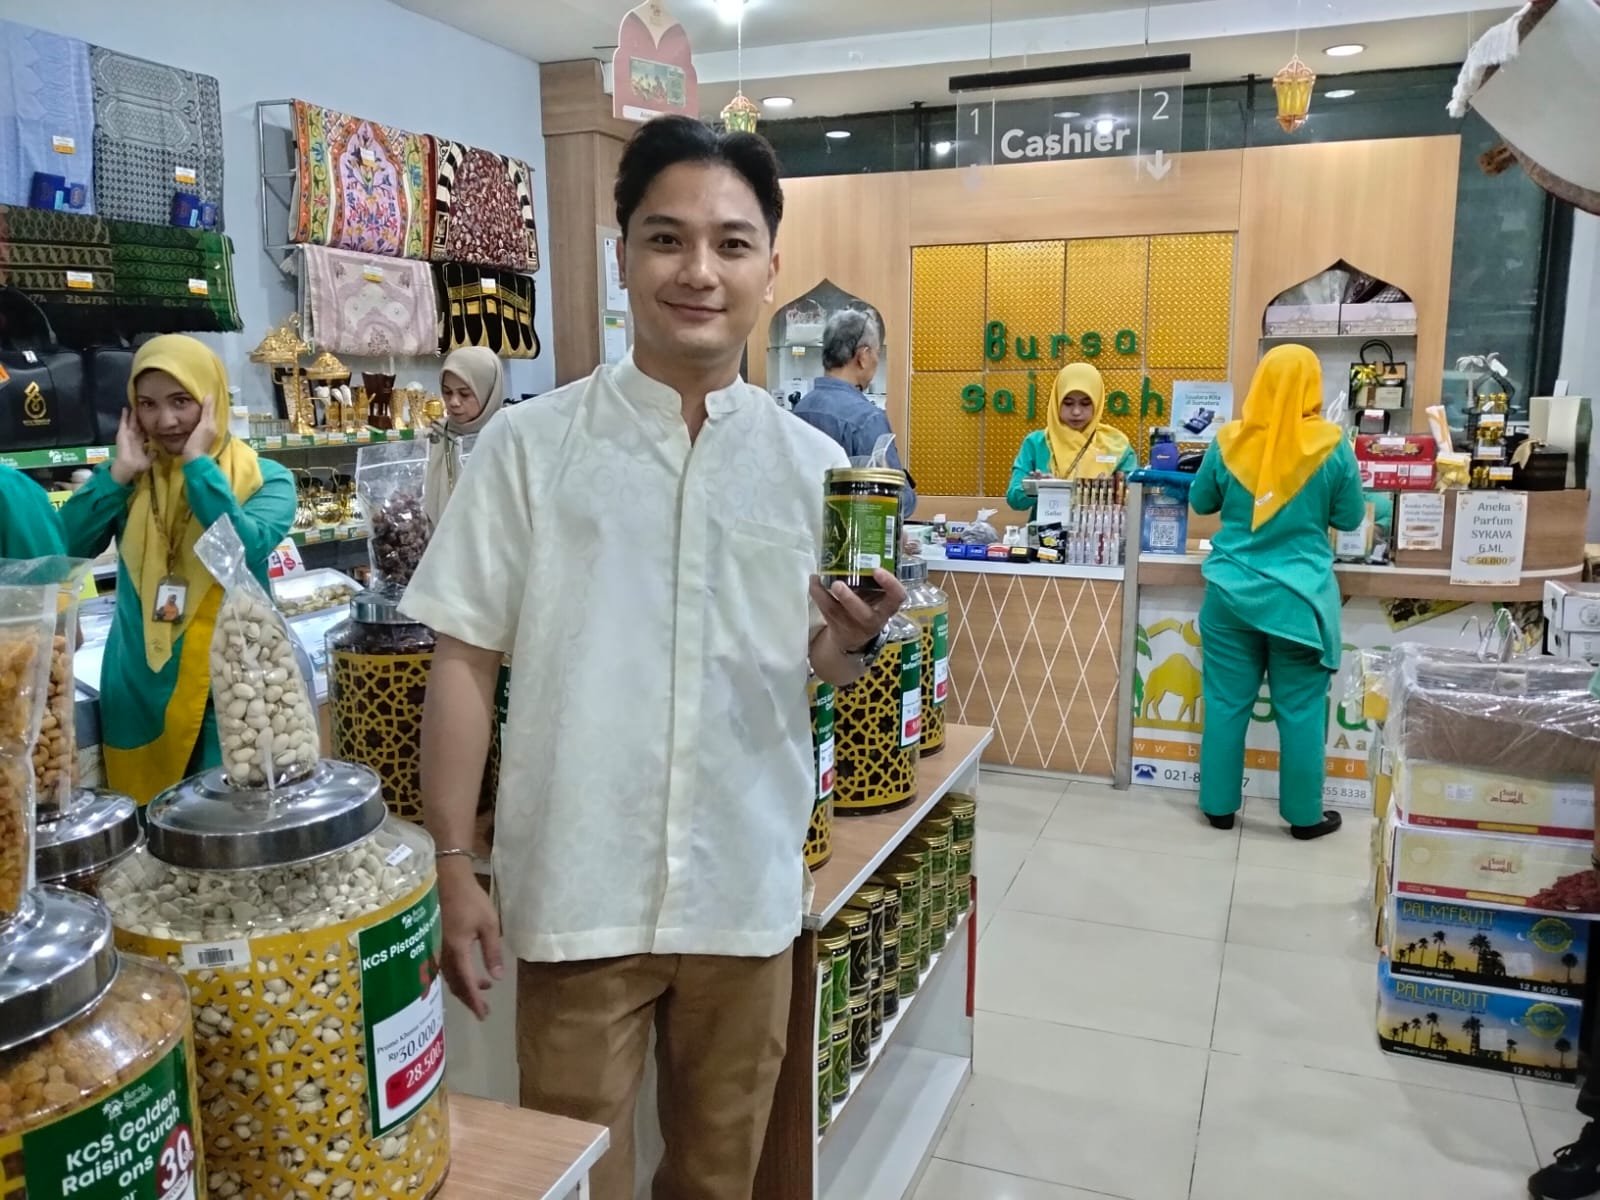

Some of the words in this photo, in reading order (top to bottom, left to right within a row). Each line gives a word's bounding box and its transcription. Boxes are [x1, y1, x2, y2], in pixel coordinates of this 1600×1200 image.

[1152, 91, 1170, 120] 2
[969, 108, 980, 135] 1
[1001, 123, 1131, 159] Cashier
[985, 320, 1138, 361] Bursa
[1478, 502, 1511, 512] Aneka
[1473, 516, 1513, 526] Parfum
[1341, 787, 1367, 798] 8338
[363, 950, 389, 971] KCS
[410, 941, 425, 959] ons
[1519, 983, 1528, 991] 12
[1513, 1066, 1522, 1074] 12
[67, 1133, 115, 1173] KCS
[119, 1089, 177, 1142] Golden
[62, 1148, 133, 1197] Raisin
[136, 1106, 181, 1152] Curah
[118, 1154, 154, 1187] ons
